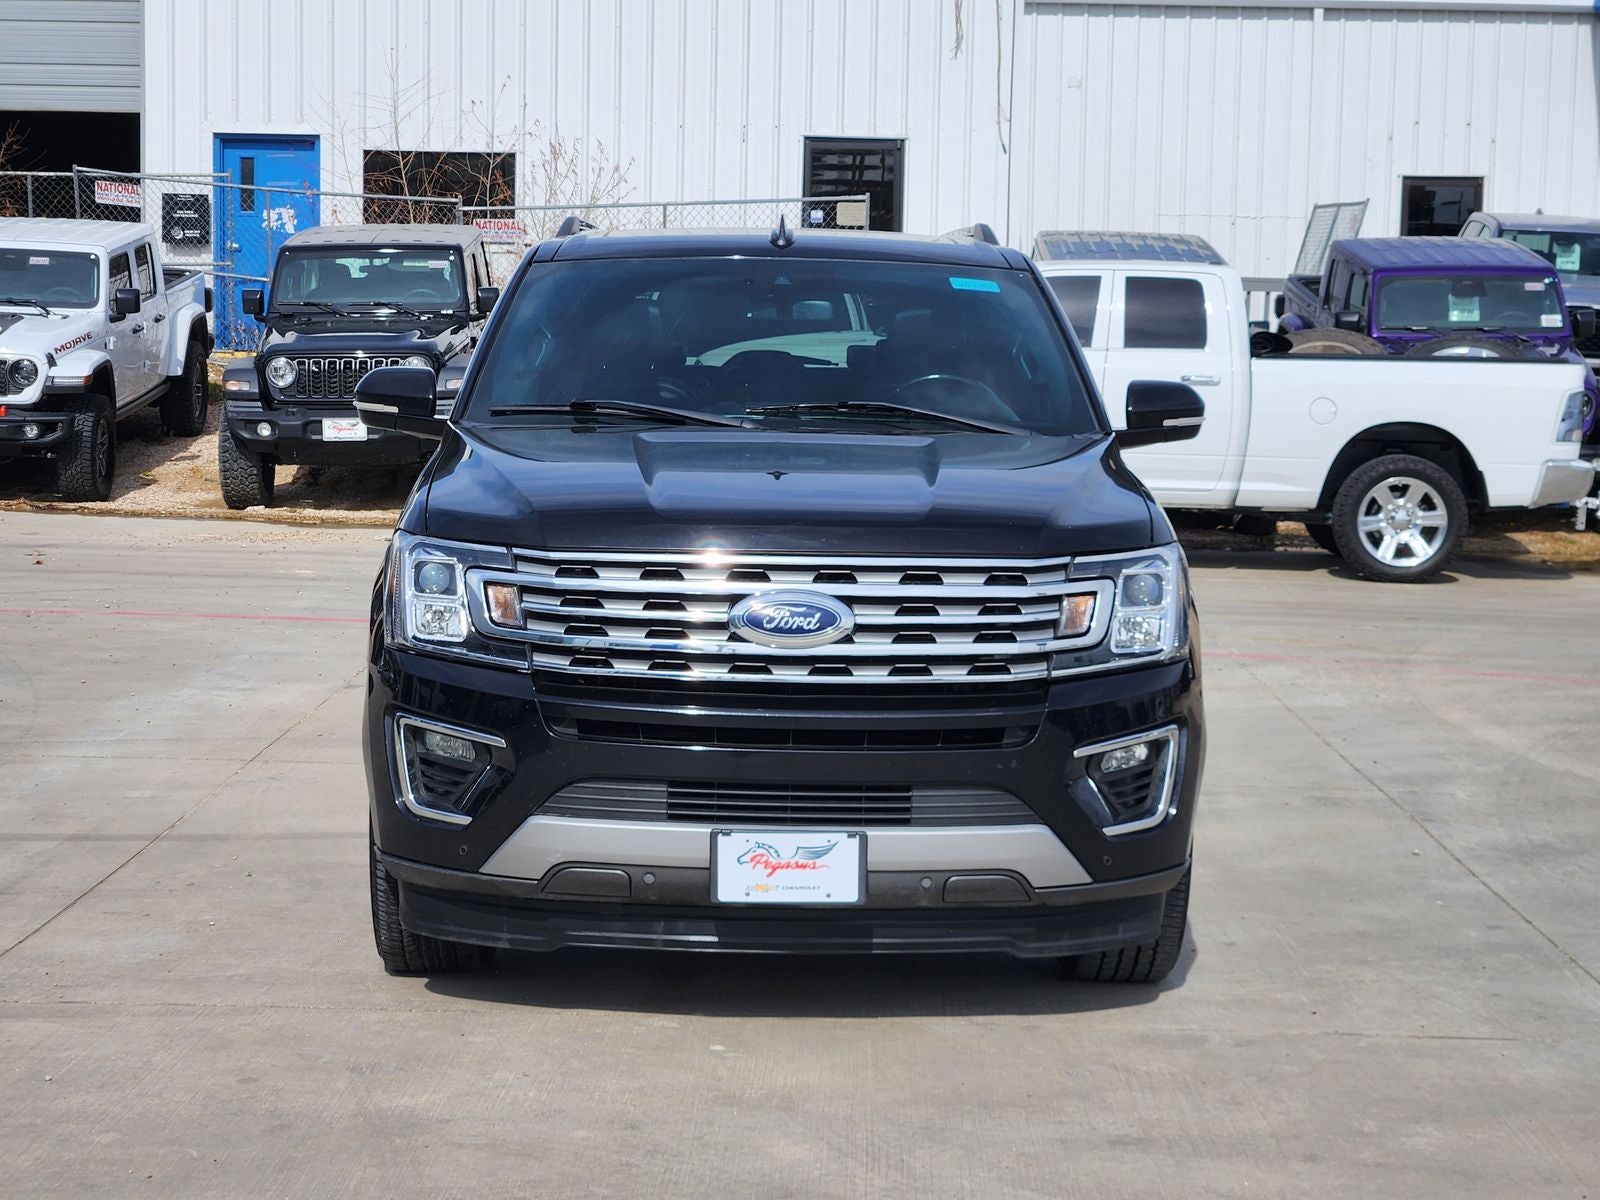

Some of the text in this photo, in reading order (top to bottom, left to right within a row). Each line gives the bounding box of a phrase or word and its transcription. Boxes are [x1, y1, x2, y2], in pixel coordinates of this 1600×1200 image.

[96, 182, 142, 195] NATIONAL
[475, 220, 522, 231] NATIONAL
[54, 331, 93, 355] MOJAVE
[763, 605, 821, 631] Ford
[750, 853, 831, 878] Pegasus
